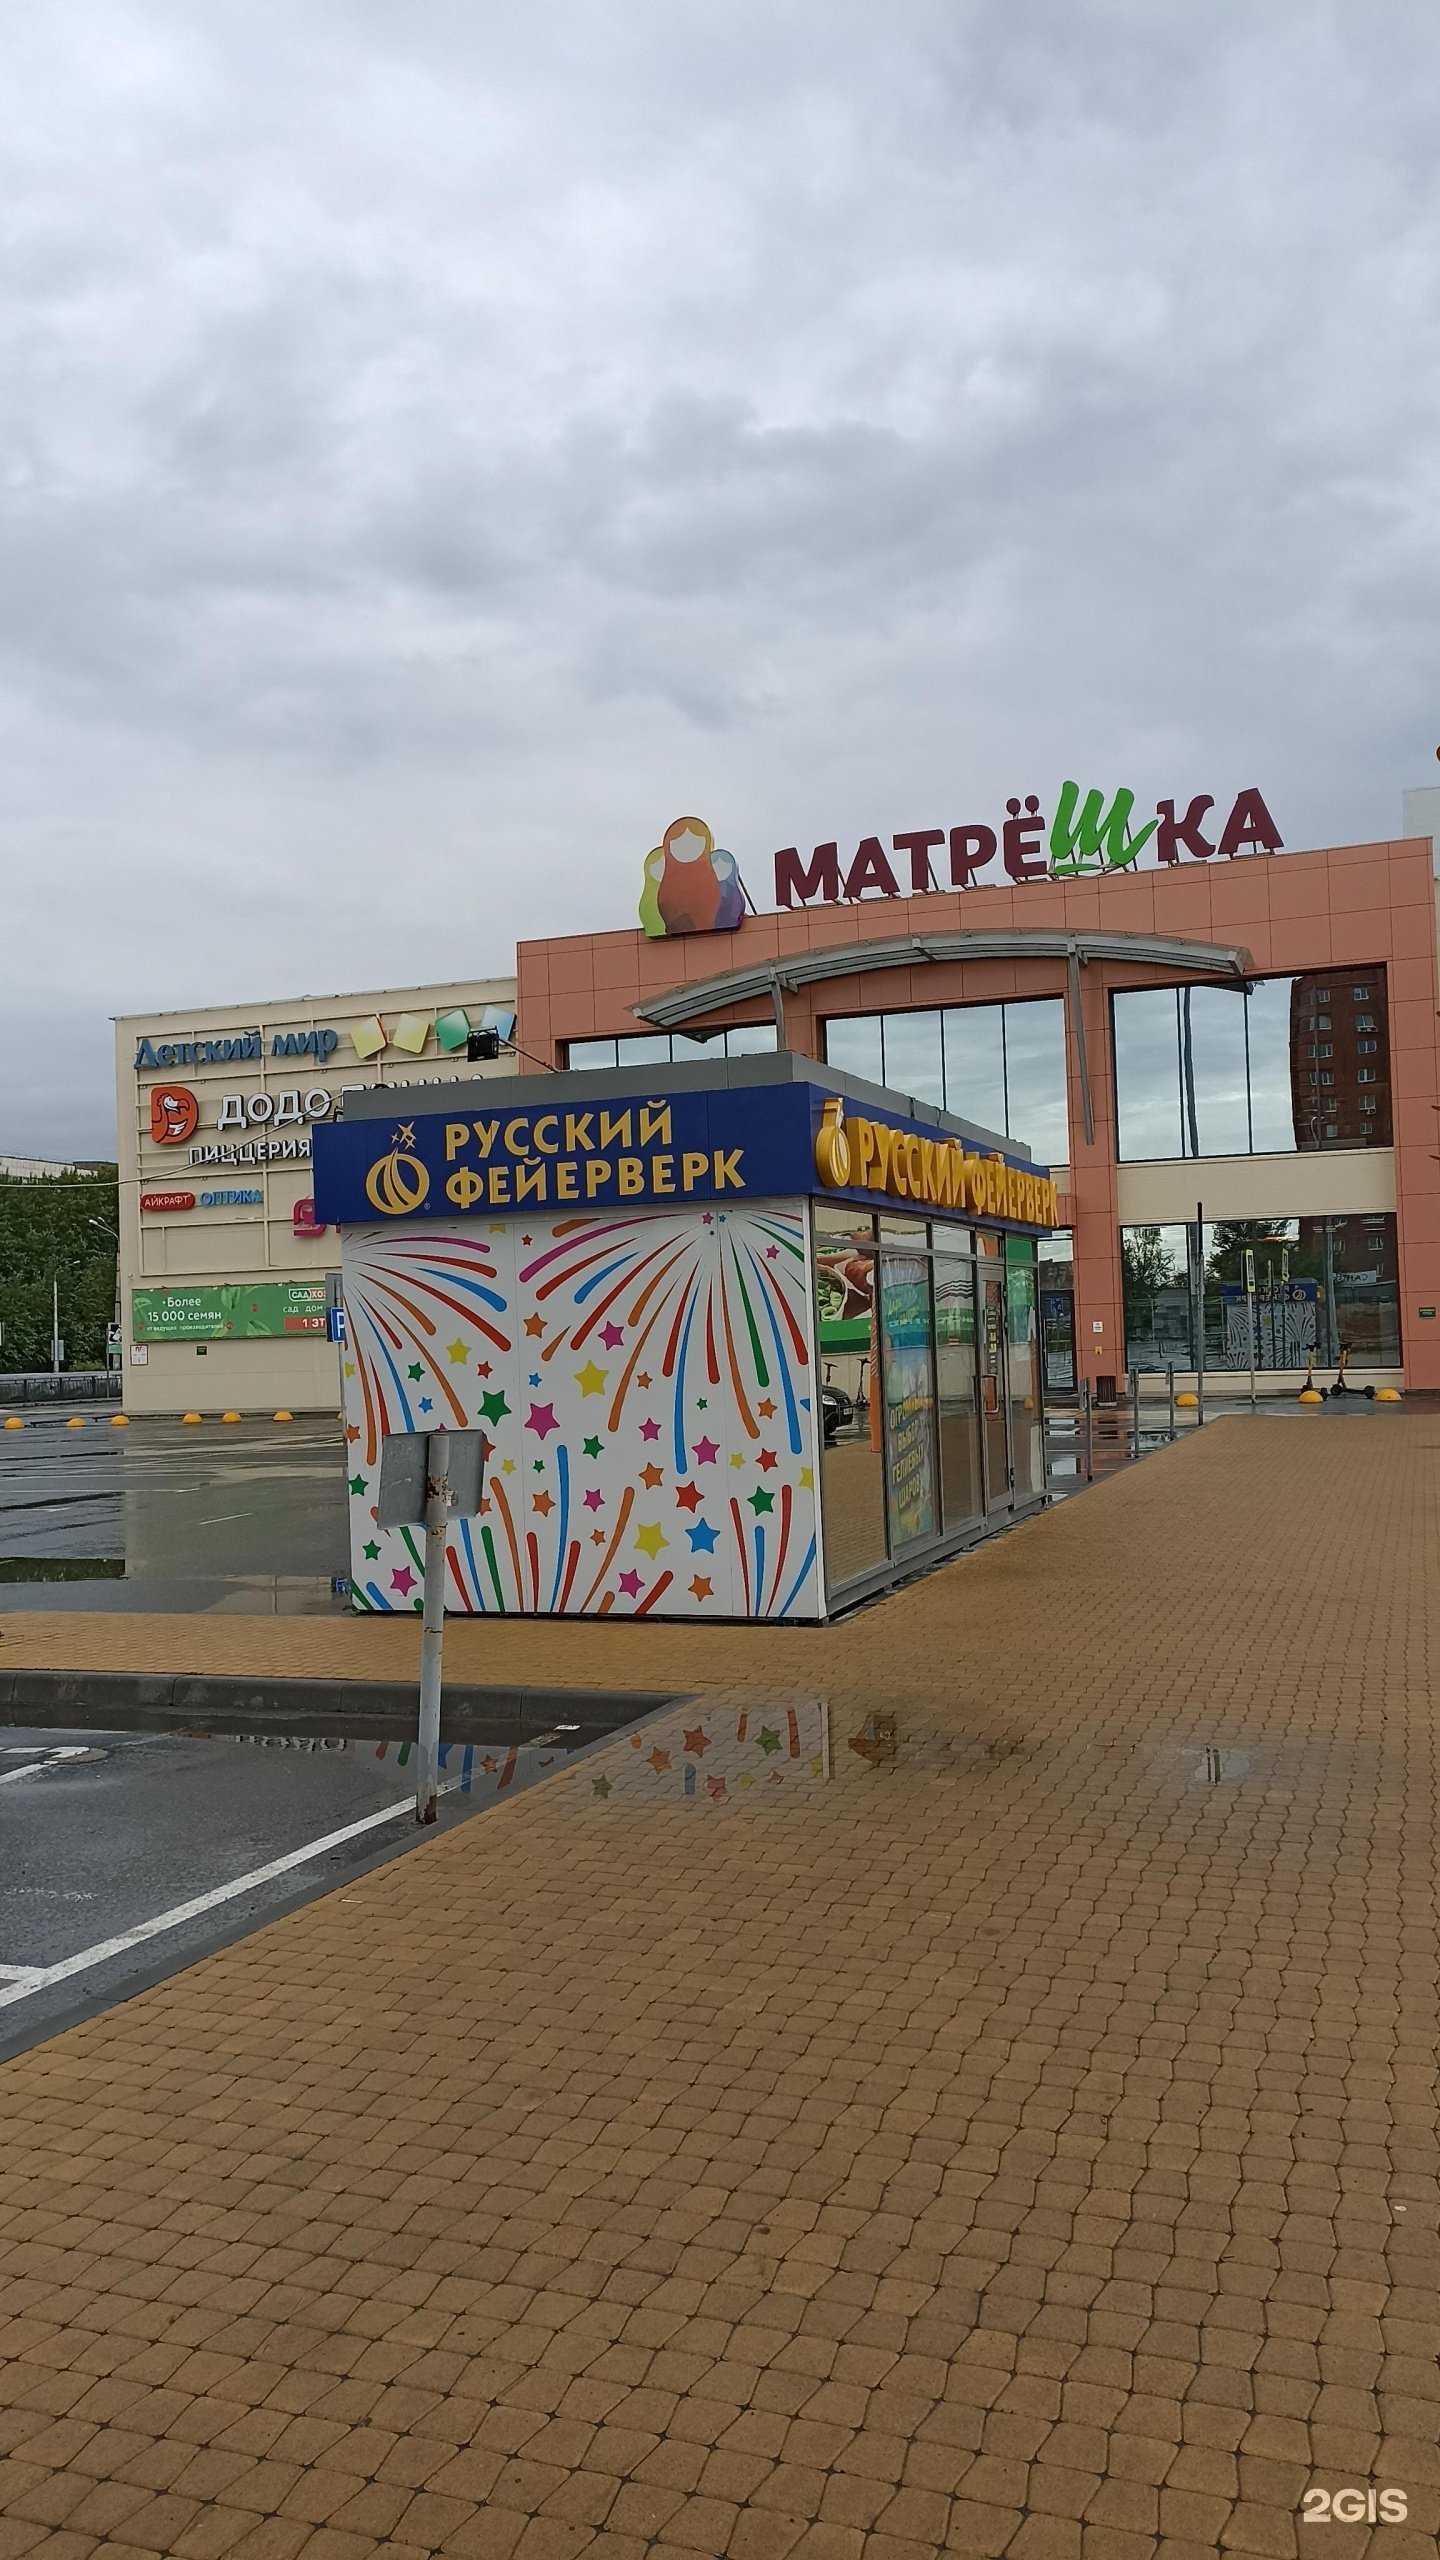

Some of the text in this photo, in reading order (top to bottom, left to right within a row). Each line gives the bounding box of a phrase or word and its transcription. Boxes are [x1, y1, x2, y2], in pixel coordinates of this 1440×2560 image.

[774, 780, 1284, 908] МАТРЁШКА
[134, 1028, 338, 1069] Детский мир
[217, 1087, 332, 1131] ДОДО
[445, 1099, 672, 1161] РУССКИЙ
[189, 1138, 312, 1166] ПИЦЦЕРИЯ
[848, 1117, 1060, 1228] РУССКИЙ ФЕЙЕРВЕРК
[145, 1190, 262, 1208] АЙКРАФТ ОПТИКА
[445, 1149, 747, 1209] ФЕЙЕРВЕРК
[147, 1310, 222, 1321] 15 000 семян
[166, 1297, 202, 1308] Более
